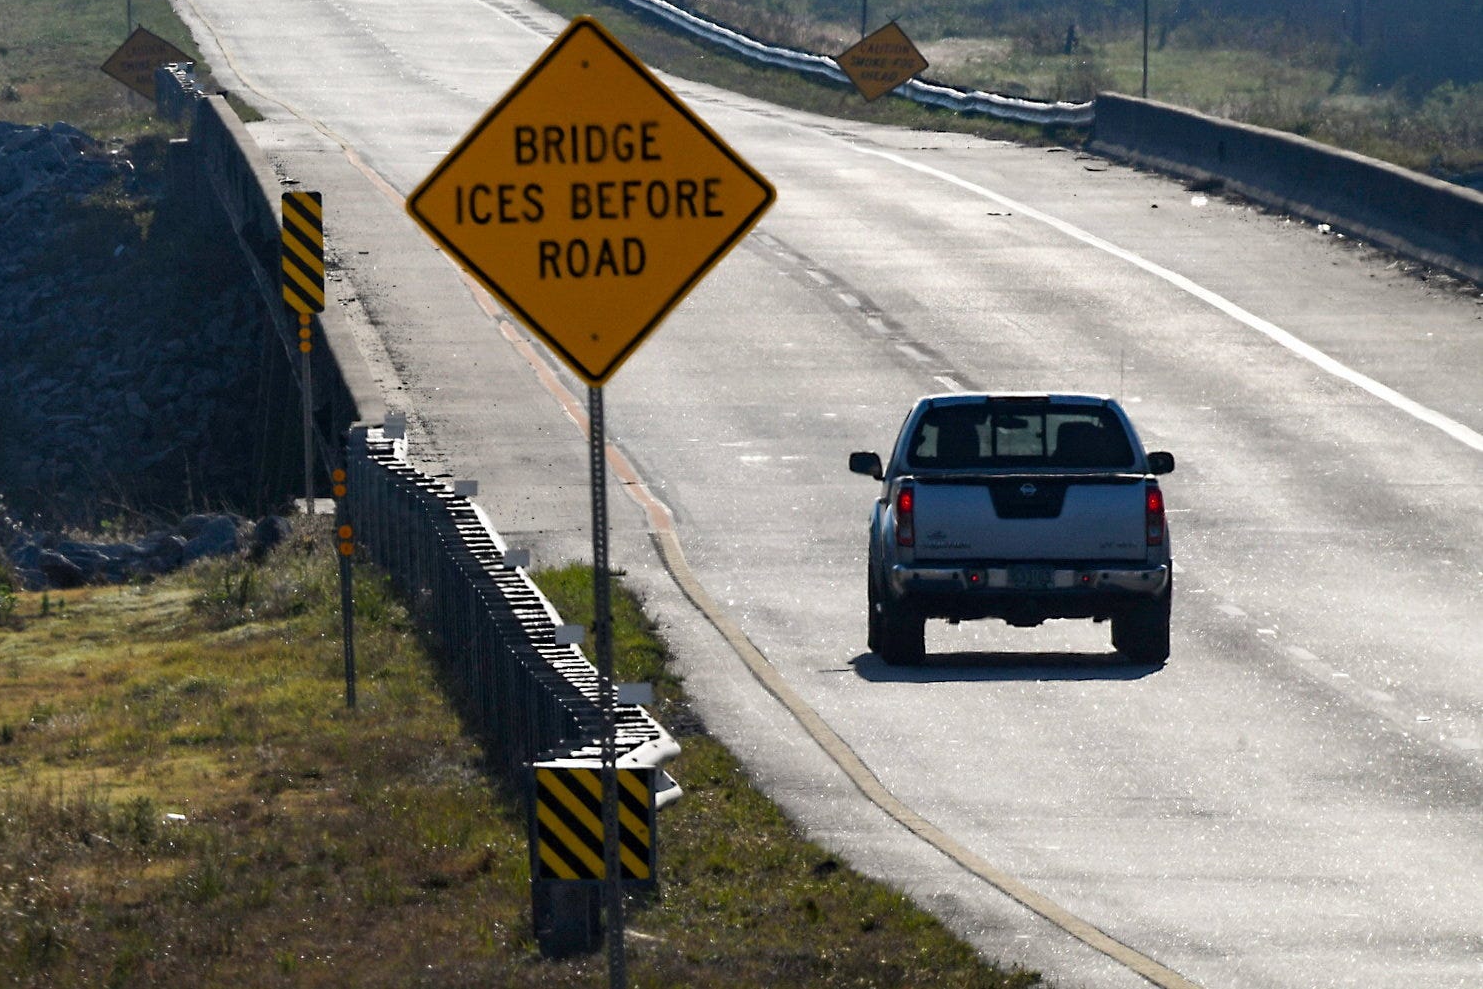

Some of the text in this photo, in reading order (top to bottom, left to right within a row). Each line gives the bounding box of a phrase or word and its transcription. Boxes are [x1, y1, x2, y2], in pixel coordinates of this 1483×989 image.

[860, 42, 910, 54] CAUTION
[514, 122, 662, 166] BRIDGE
[456, 179, 724, 225] ICES BEFORE
[539, 238, 647, 280] ROAD
